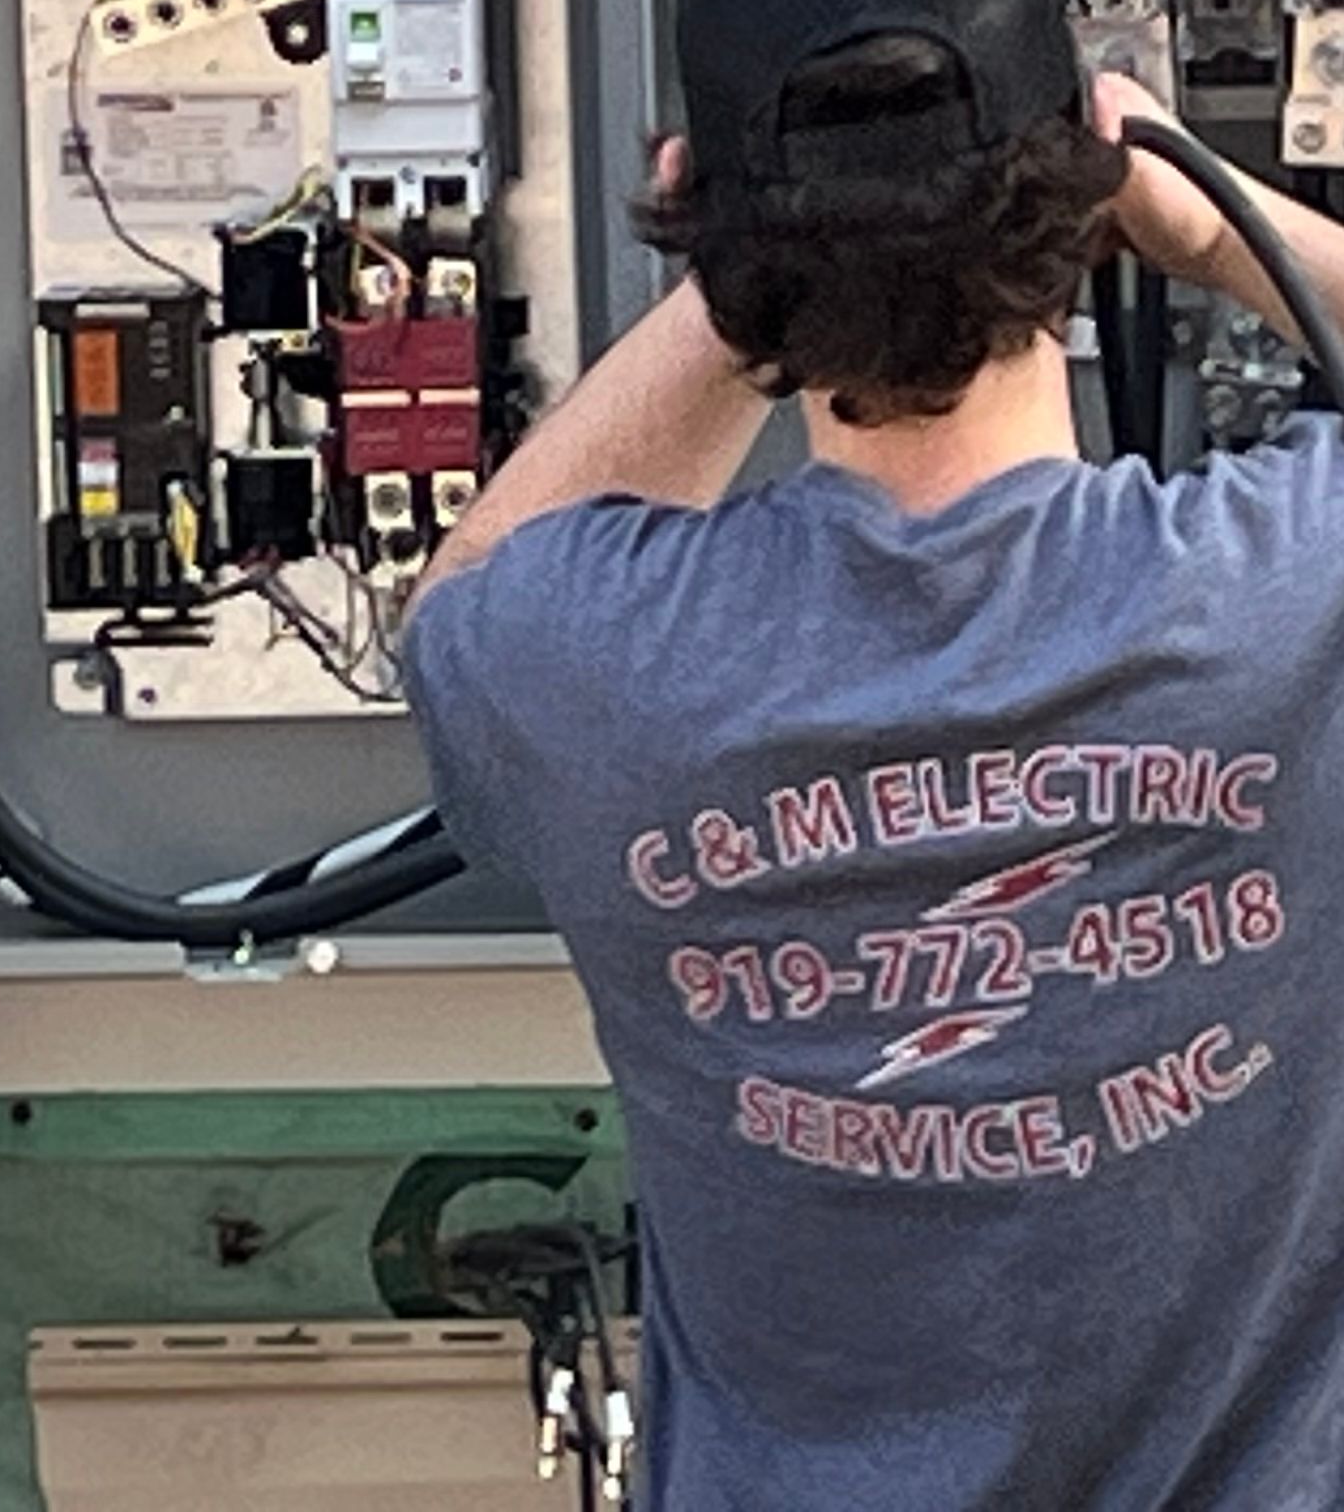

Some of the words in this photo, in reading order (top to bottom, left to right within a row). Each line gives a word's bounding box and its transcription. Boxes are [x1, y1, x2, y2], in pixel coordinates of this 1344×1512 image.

[866, 744, 1279, 846] ELECTRIC
[668, 868, 1286, 1024] 919-772-4518
[736, 1076, 1096, 1178] SERVICE,
[1096, 1023, 1273, 1153] INC.
